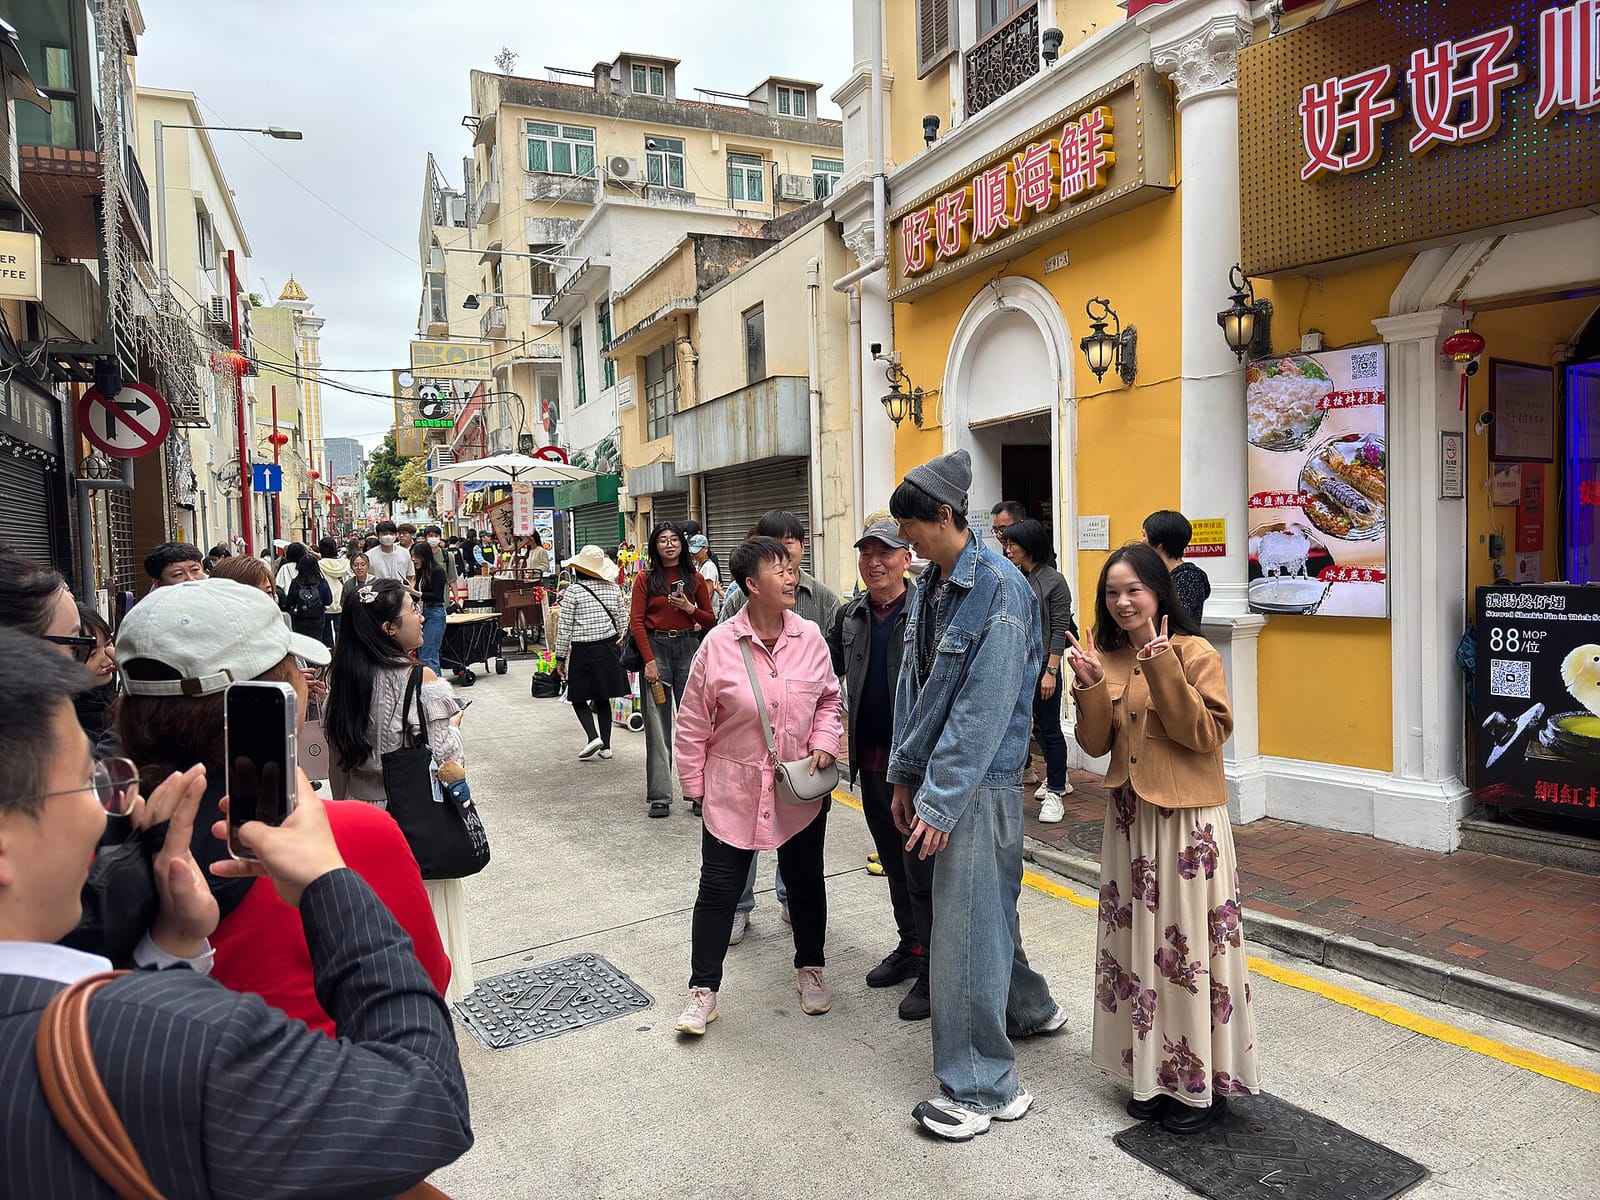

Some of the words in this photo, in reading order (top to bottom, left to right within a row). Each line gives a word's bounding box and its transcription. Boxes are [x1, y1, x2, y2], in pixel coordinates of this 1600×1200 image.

[902, 106, 1114, 277] 好好順海鮮
[0, 269, 27, 280] FEE
[1490, 627, 1520, 653] 88
[1522, 630, 1547, 640] MOP
[1521, 640, 1540, 654] /位
